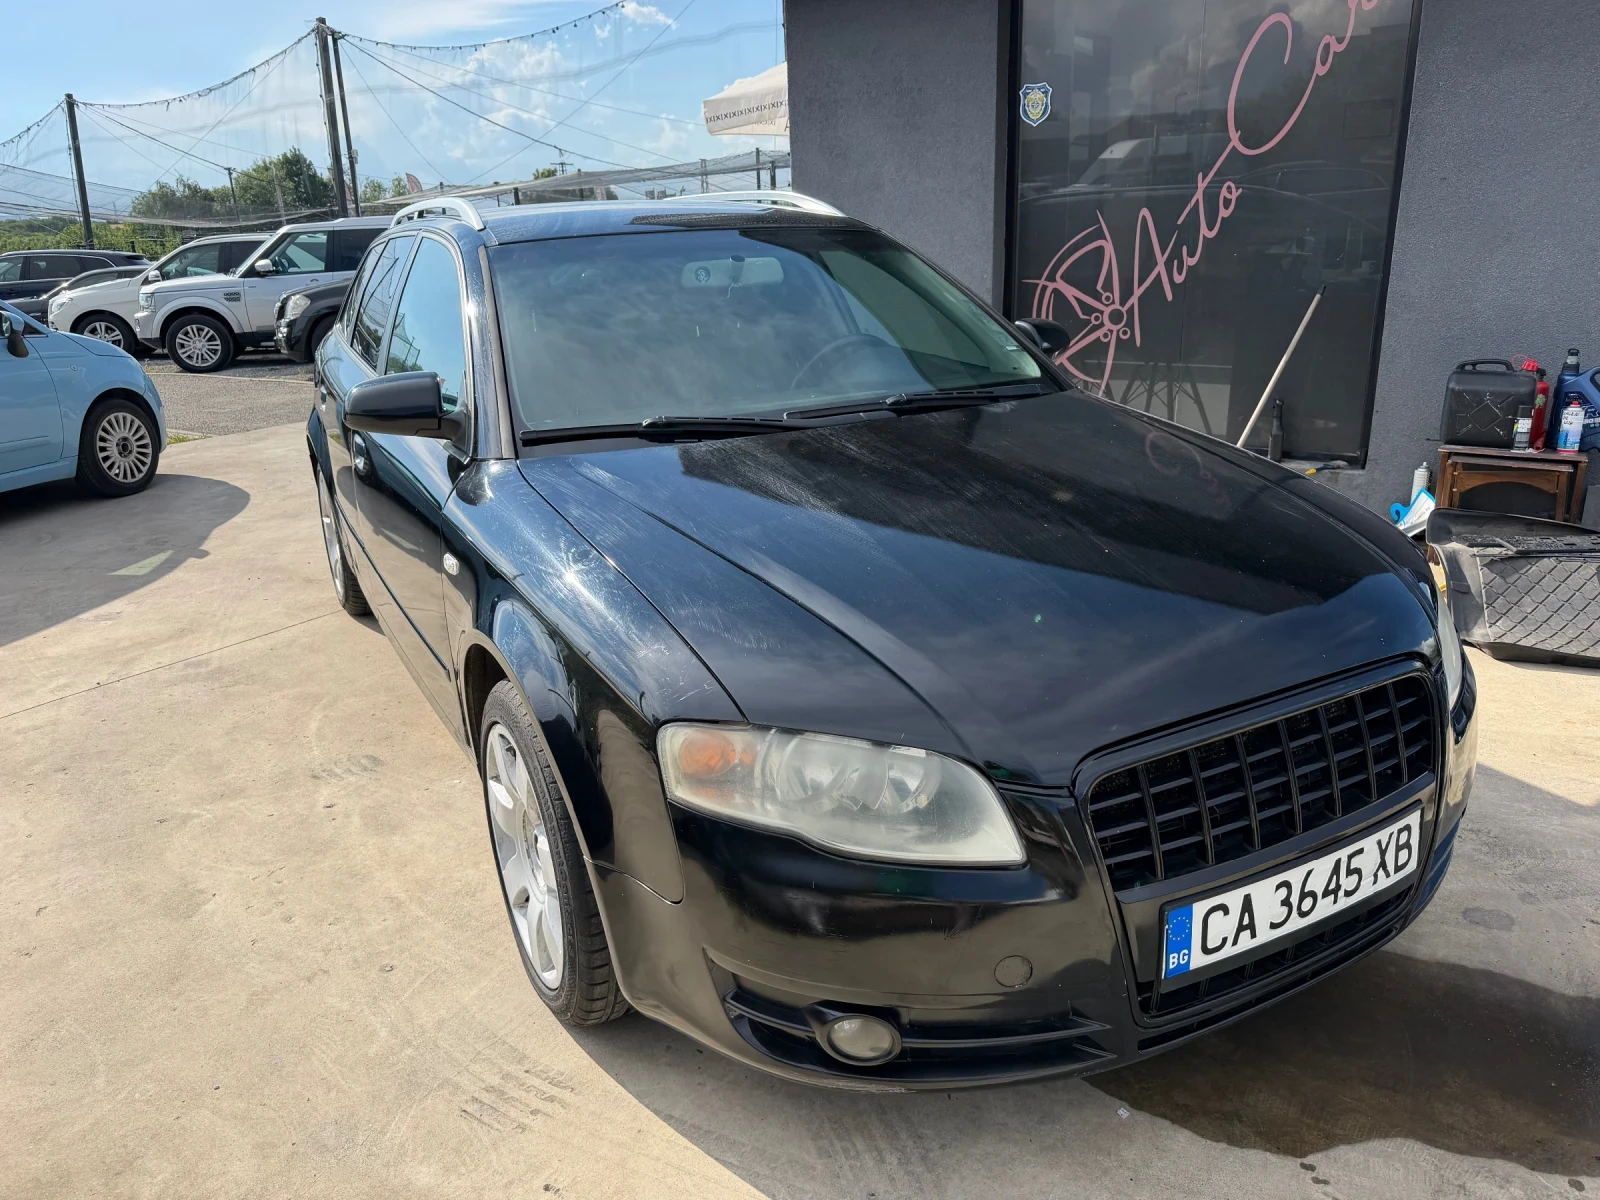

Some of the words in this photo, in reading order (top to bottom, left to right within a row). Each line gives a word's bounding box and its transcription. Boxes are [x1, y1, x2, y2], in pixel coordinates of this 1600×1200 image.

[1122, 132, 1242, 347] Auto
[1200, 893, 1257, 956] CA
[1269, 847, 1365, 930] 3645
[1372, 823, 1413, 885] XB
[1168, 949, 1190, 970] BG
